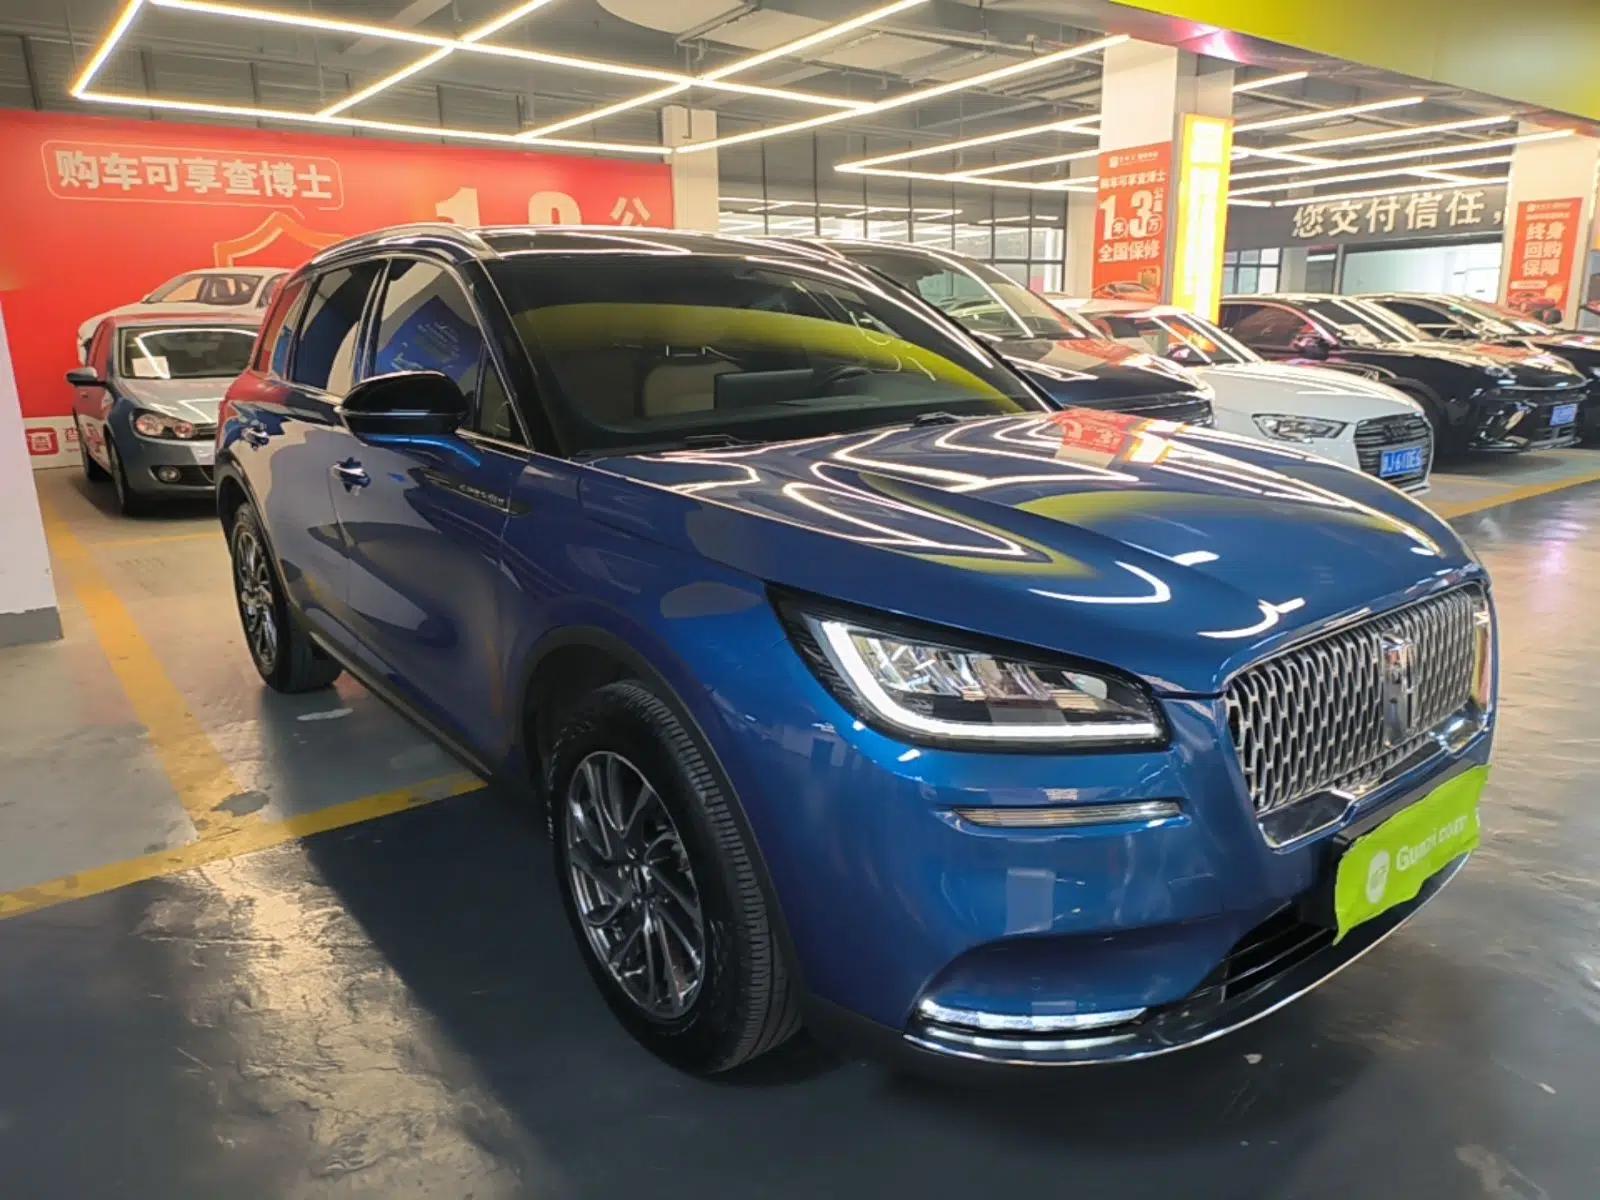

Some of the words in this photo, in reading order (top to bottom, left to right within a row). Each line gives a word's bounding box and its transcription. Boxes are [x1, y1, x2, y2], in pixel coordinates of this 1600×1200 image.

[55, 150, 333, 199] 购车可享查博士
